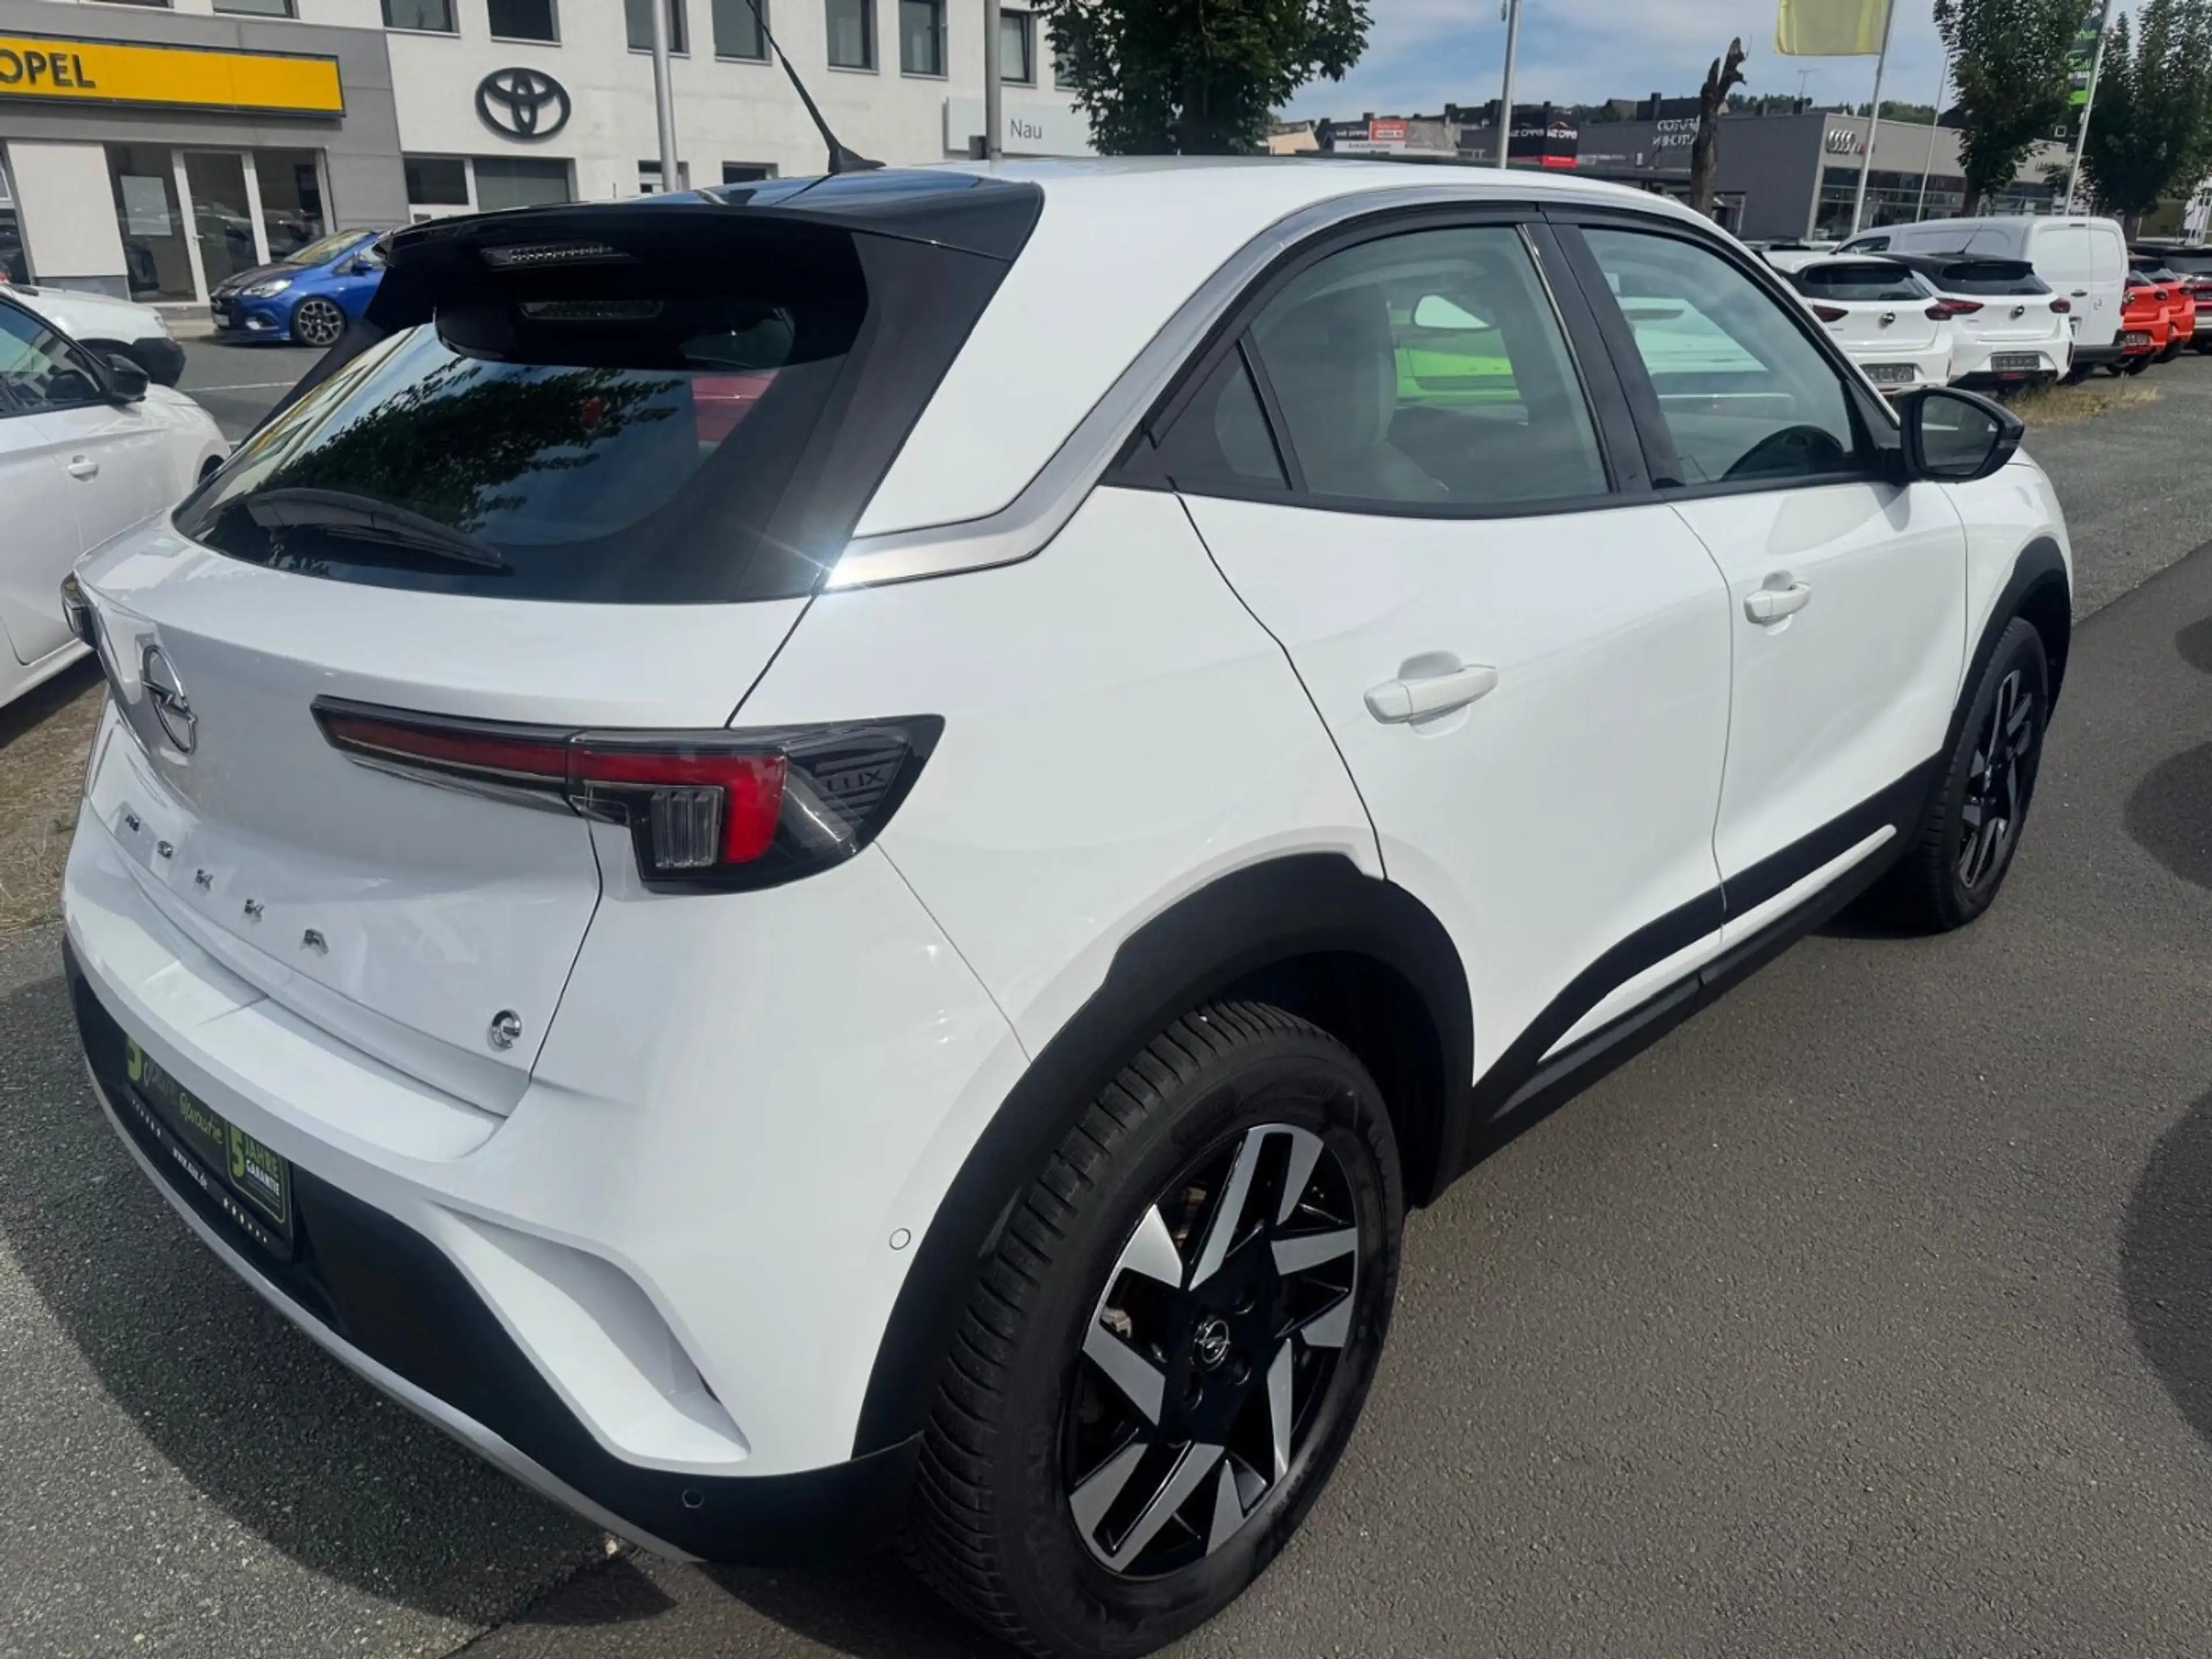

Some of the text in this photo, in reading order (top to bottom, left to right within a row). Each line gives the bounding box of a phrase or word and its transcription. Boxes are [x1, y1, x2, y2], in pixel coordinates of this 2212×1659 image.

[0, 48, 97, 88] OPEL
[1010, 118, 1043, 139] Nau
[124, 813, 329, 957] MOKKA
[230, 1126, 244, 1177] 5
